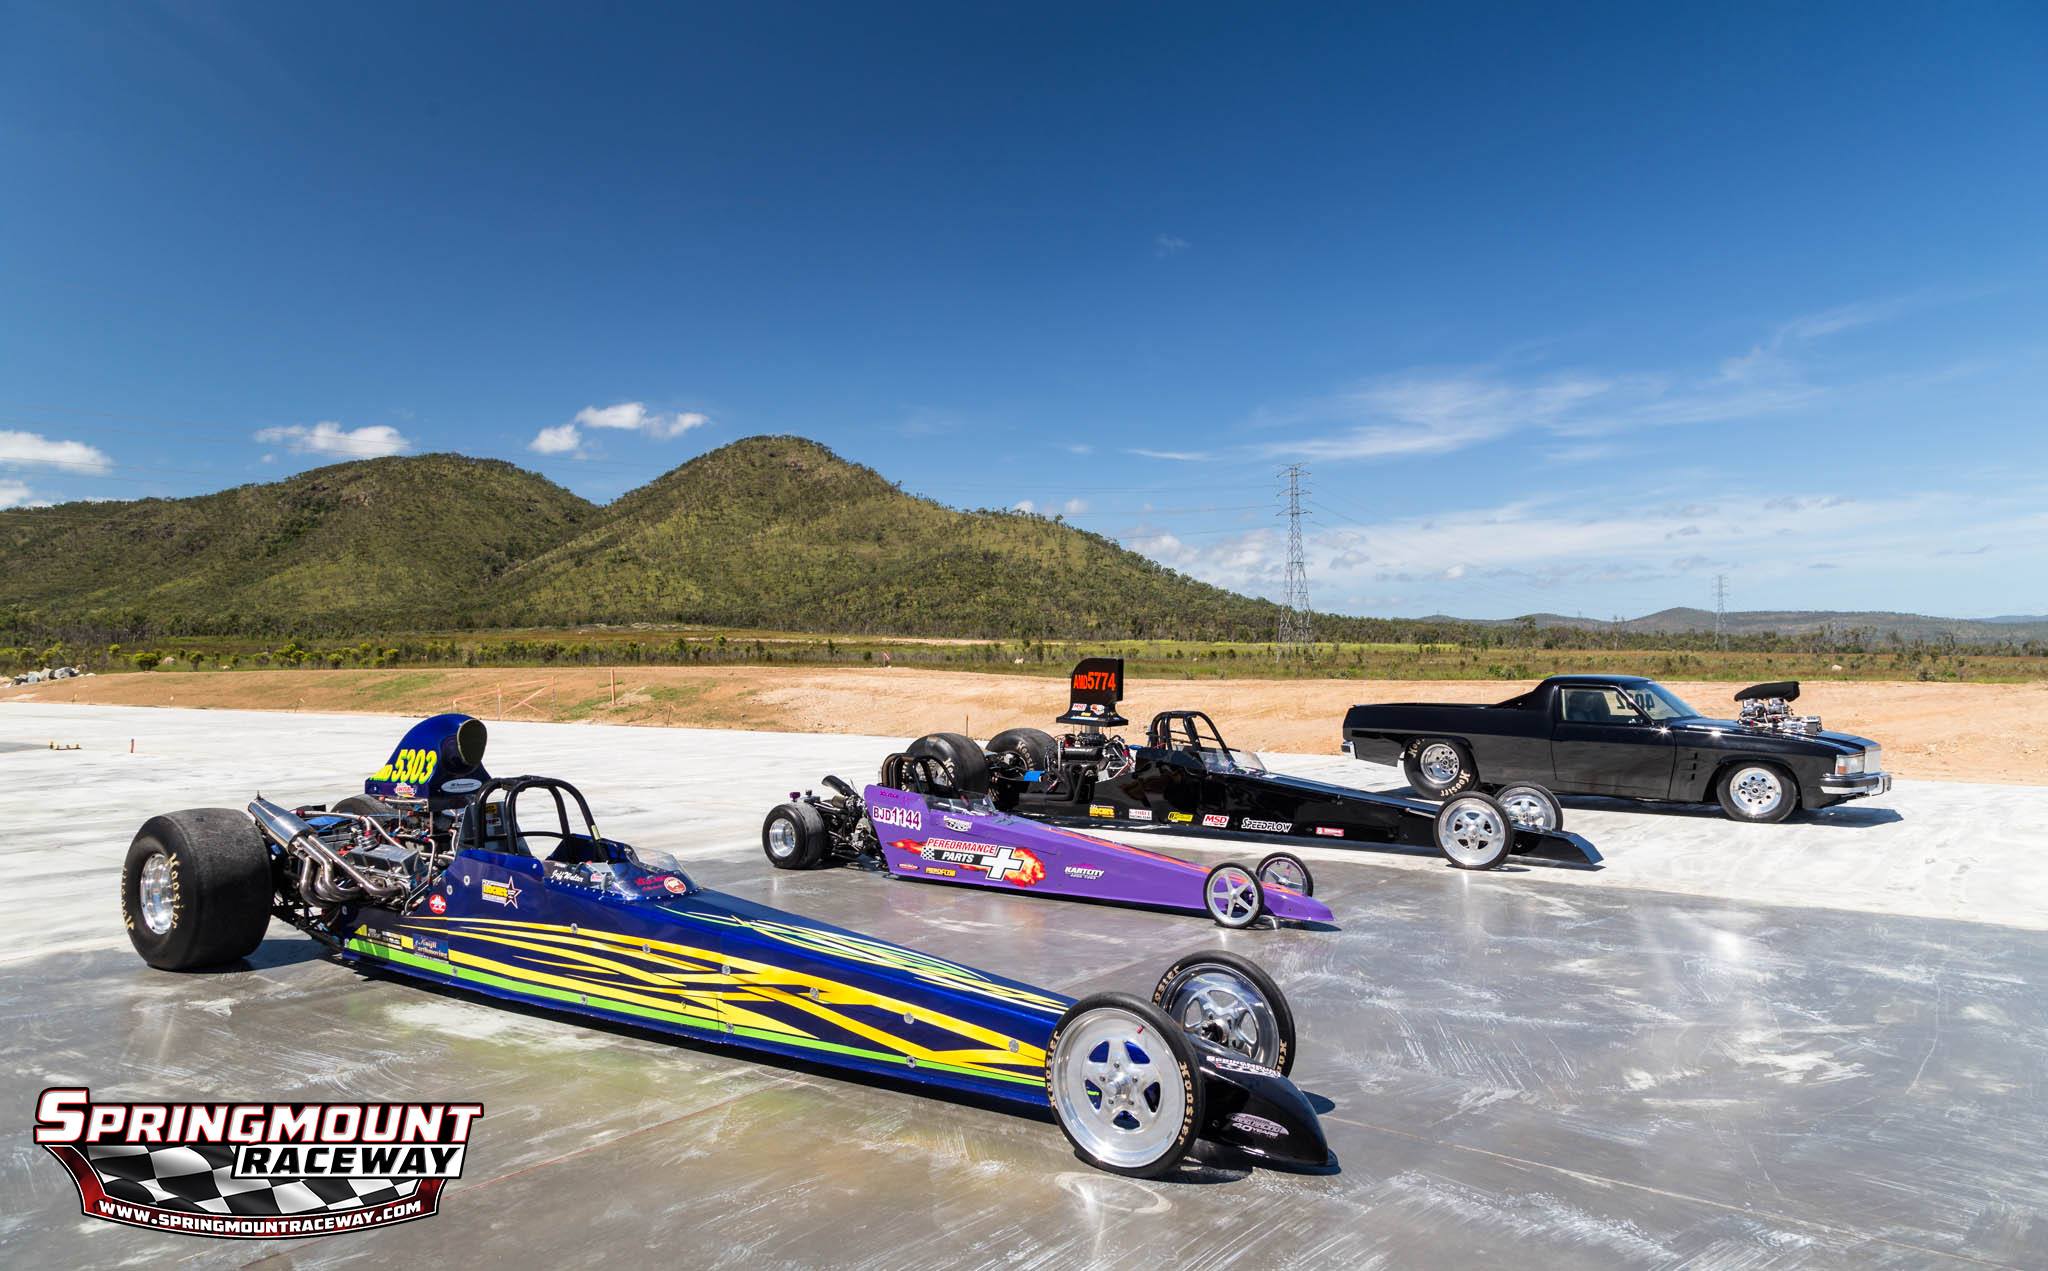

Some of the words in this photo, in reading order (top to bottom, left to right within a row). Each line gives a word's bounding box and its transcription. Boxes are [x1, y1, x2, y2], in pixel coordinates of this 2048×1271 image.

[1073, 671, 1117, 691] AMD5774
[873, 806, 921, 830] BJD1144
[1205, 815, 1227, 824] MSD
[1241, 817, 1293, 833] SPEEDFLOW
[926, 838, 996, 854] PERFORMANCE
[941, 851, 974, 863] PARTS
[1178, 1061, 1194, 1146] Hoosier
